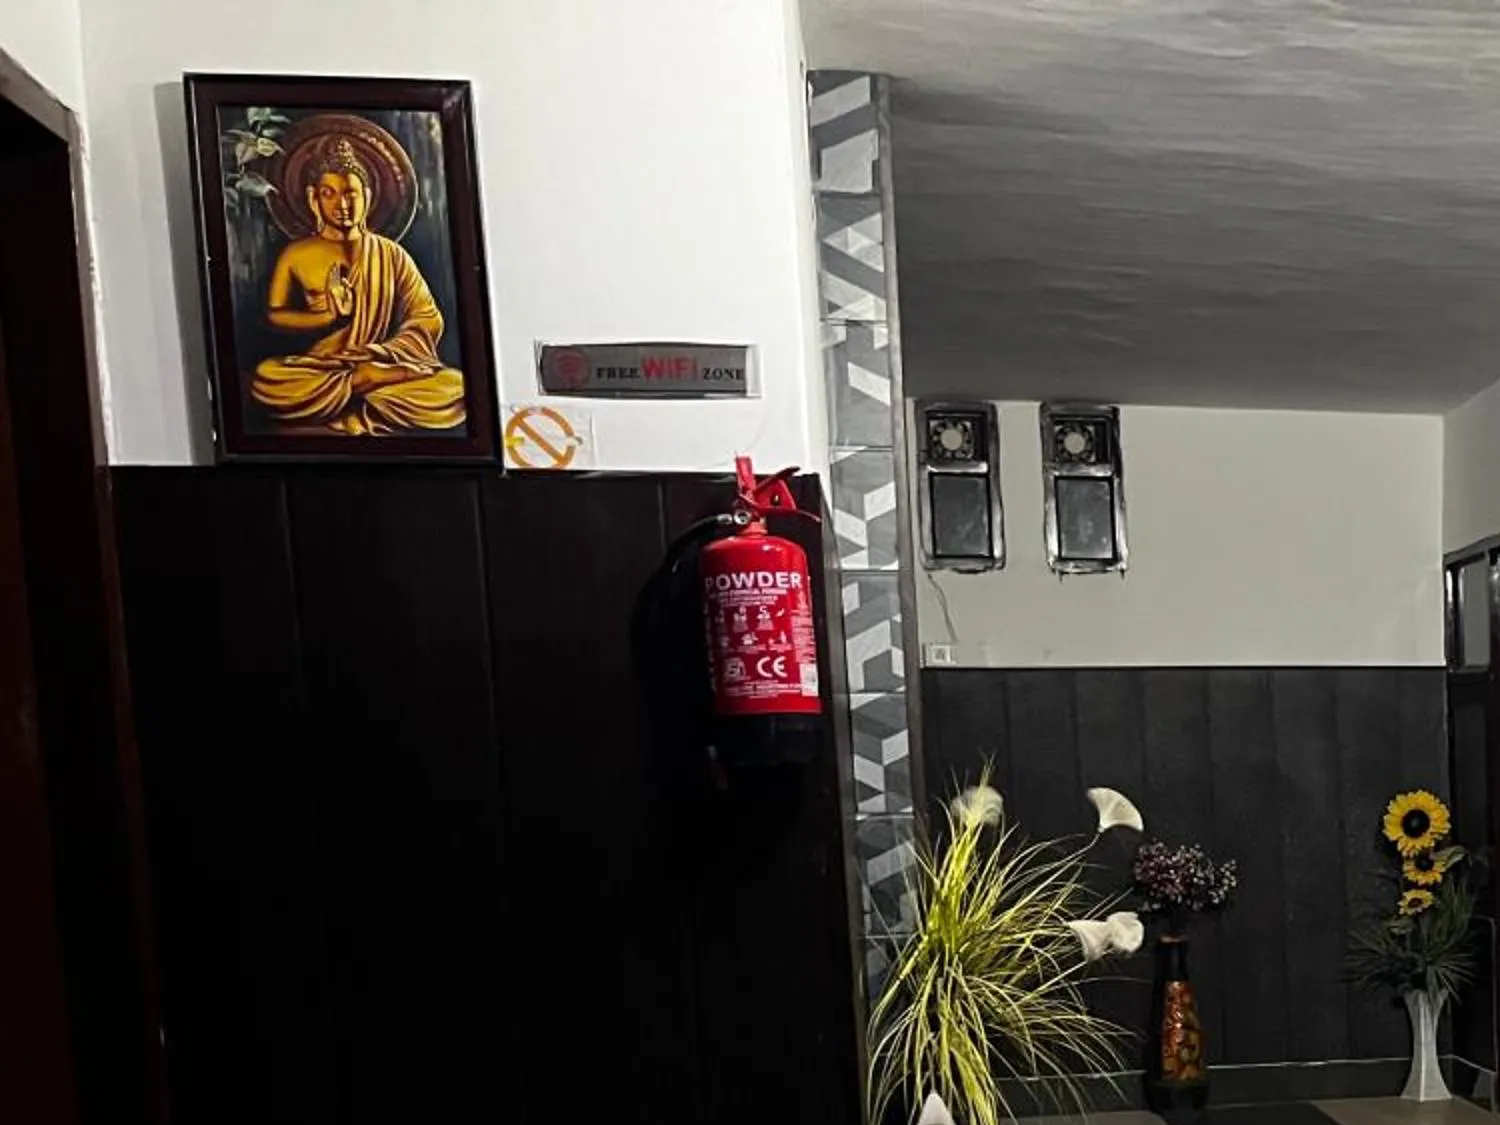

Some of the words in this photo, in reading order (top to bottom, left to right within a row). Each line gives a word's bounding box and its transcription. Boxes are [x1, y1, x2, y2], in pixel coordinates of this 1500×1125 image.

[596, 366, 641, 380] FREE
[702, 367, 745, 381] ZONE
[705, 571, 801, 591] POWDER
[757, 656, 788, 678] CE
